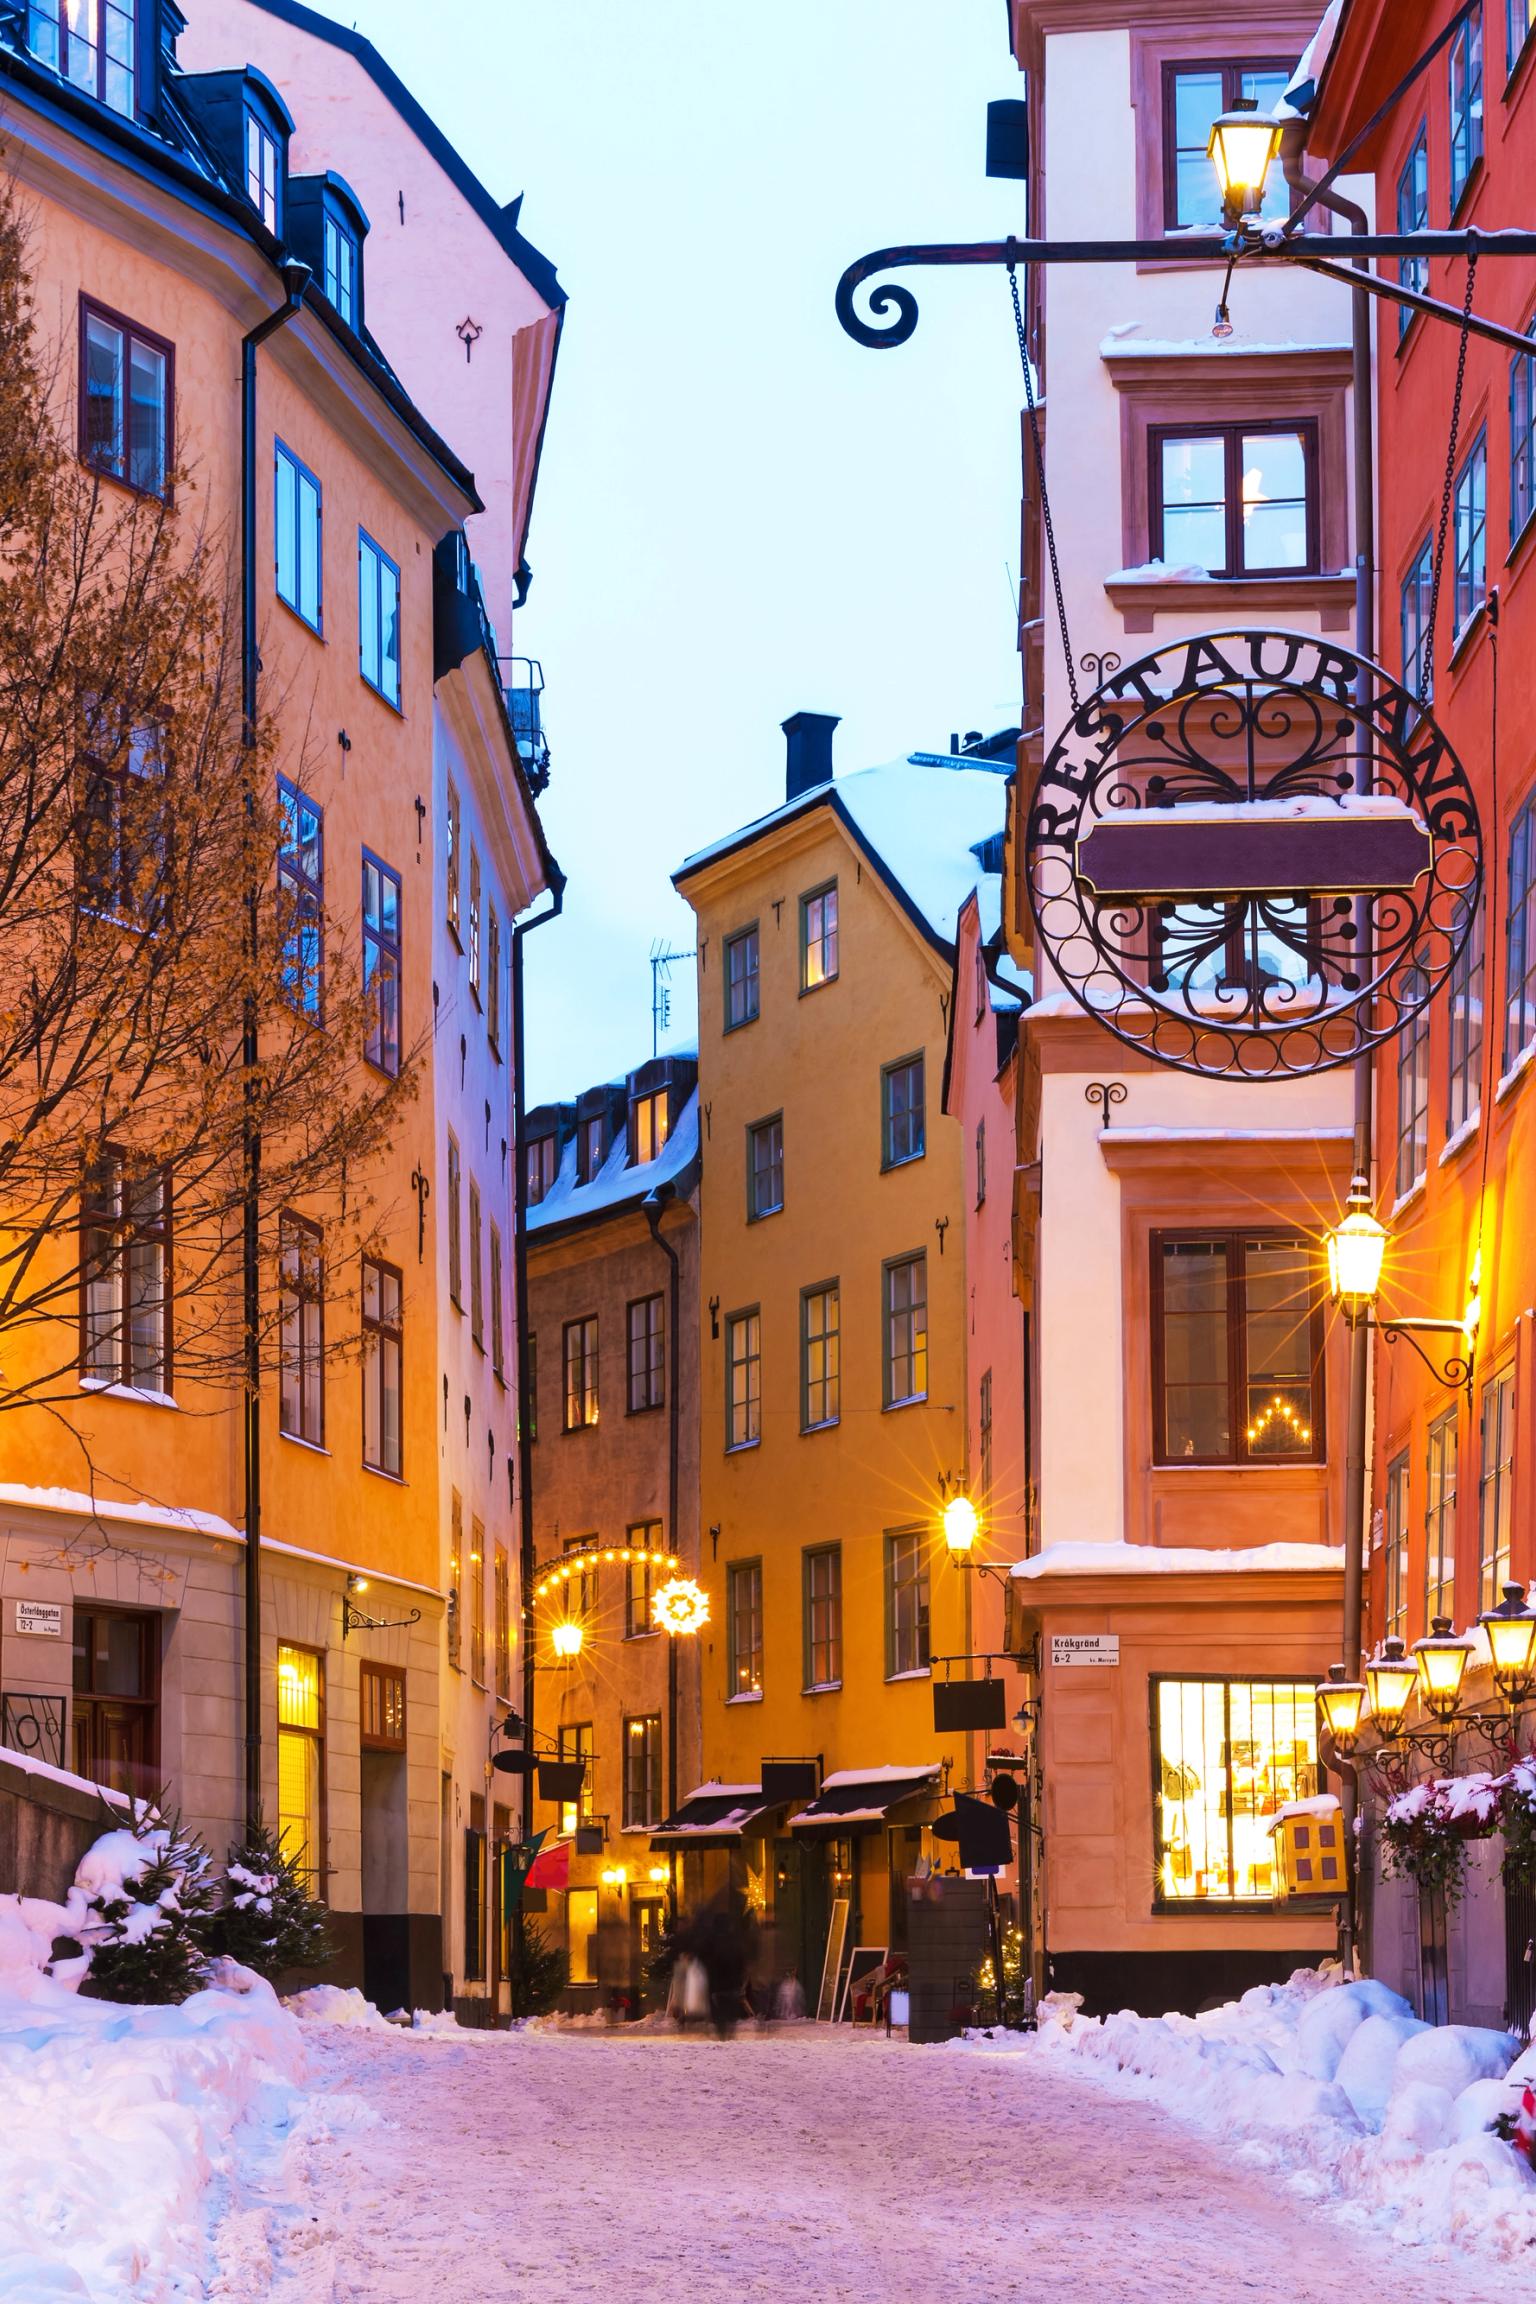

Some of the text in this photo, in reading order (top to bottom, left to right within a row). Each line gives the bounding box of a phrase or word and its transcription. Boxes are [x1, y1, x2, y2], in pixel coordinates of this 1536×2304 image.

[1032, 635, 1478, 853] RESTAURANG
[21, 1604, 59, 1618] Österlånggatan
[1054, 1638, 1100, 1649] Kråkgränd
[1054, 1654, 1071, 1663] 6-2
